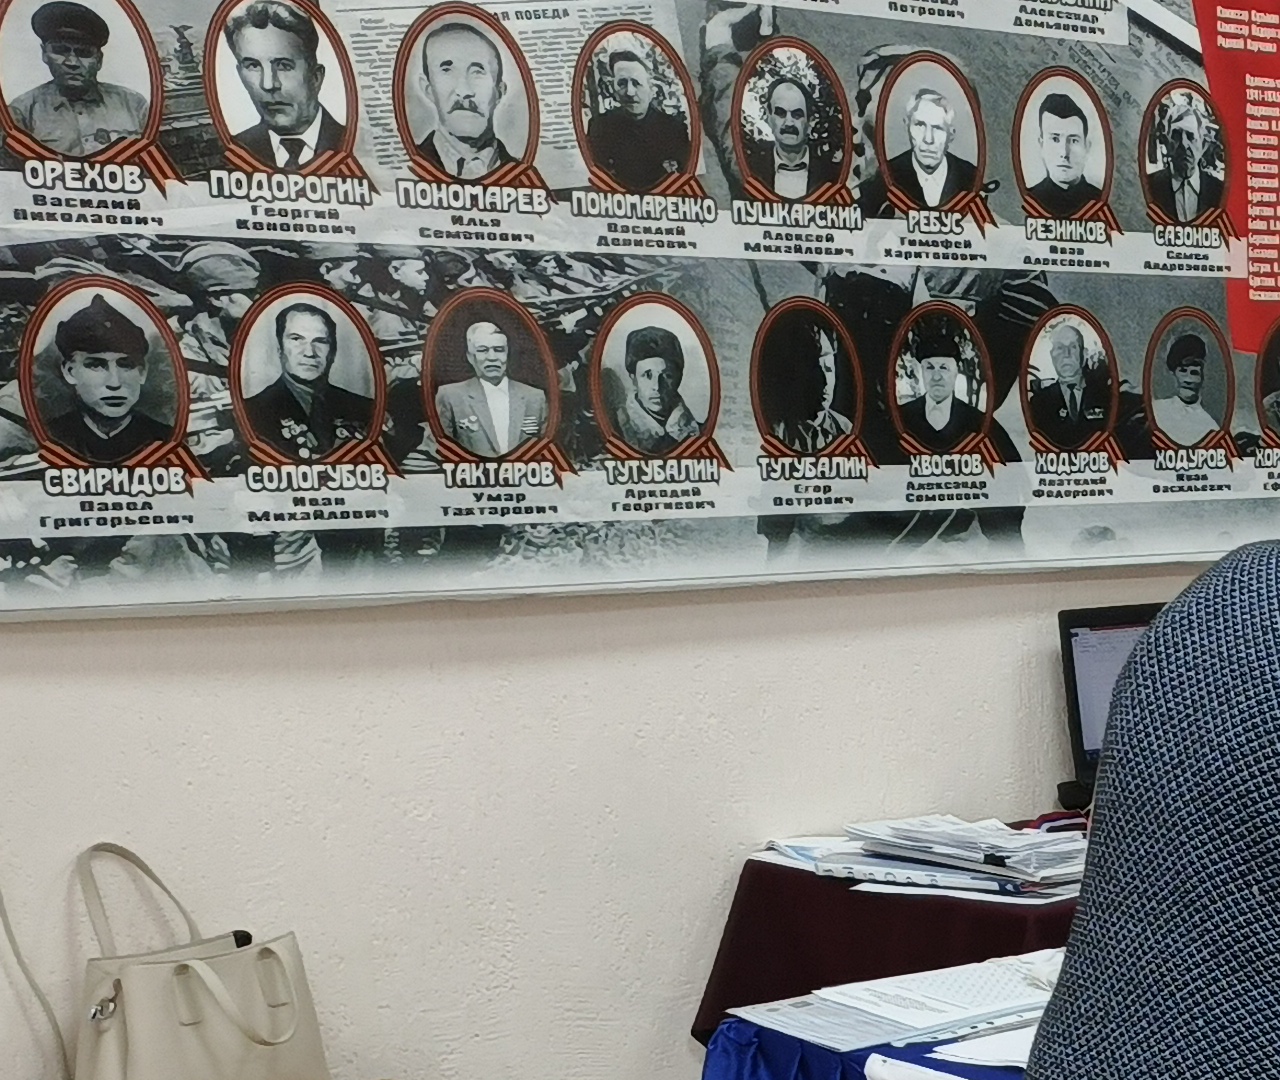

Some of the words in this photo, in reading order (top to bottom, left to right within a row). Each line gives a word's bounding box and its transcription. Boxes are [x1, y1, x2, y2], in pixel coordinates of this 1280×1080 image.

[23, 159, 145, 193] ОРЕХОВ
[209, 169, 374, 206] ПОДОРОГИН
[396, 179, 550, 214] ПОНОМАРЕВ
[571, 189, 718, 224] ПОНОМАРЕНКО
[250, 204, 339, 220] Георгий
[450, 214, 501, 228] Илья
[731, 199, 864, 231] ПУШКАРСКИЙ
[907, 209, 965, 236] РЕБУС
[1025, 216, 1109, 245] РЕЗНИКОВ
[1153, 225, 1222, 249] САЗОНОВ
[603, 458, 721, 487] ТУТУБАЛИН
[757, 455, 868, 481] ТУТУБАЛИН
[909, 453, 985, 478] ХВОСТОВ
[1035, 452, 1111, 476] ХОДУРОВ
[1154, 448, 1228, 472] ХОДУРОВ
[44, 466, 188, 497] СВИРИДОВ
[246, 463, 388, 492] СОЛОГУБОВ
[442, 461, 557, 488] ТАКТАРОВ
[472, 492, 528, 505] Умар
[793, 484, 833, 496] Егор
